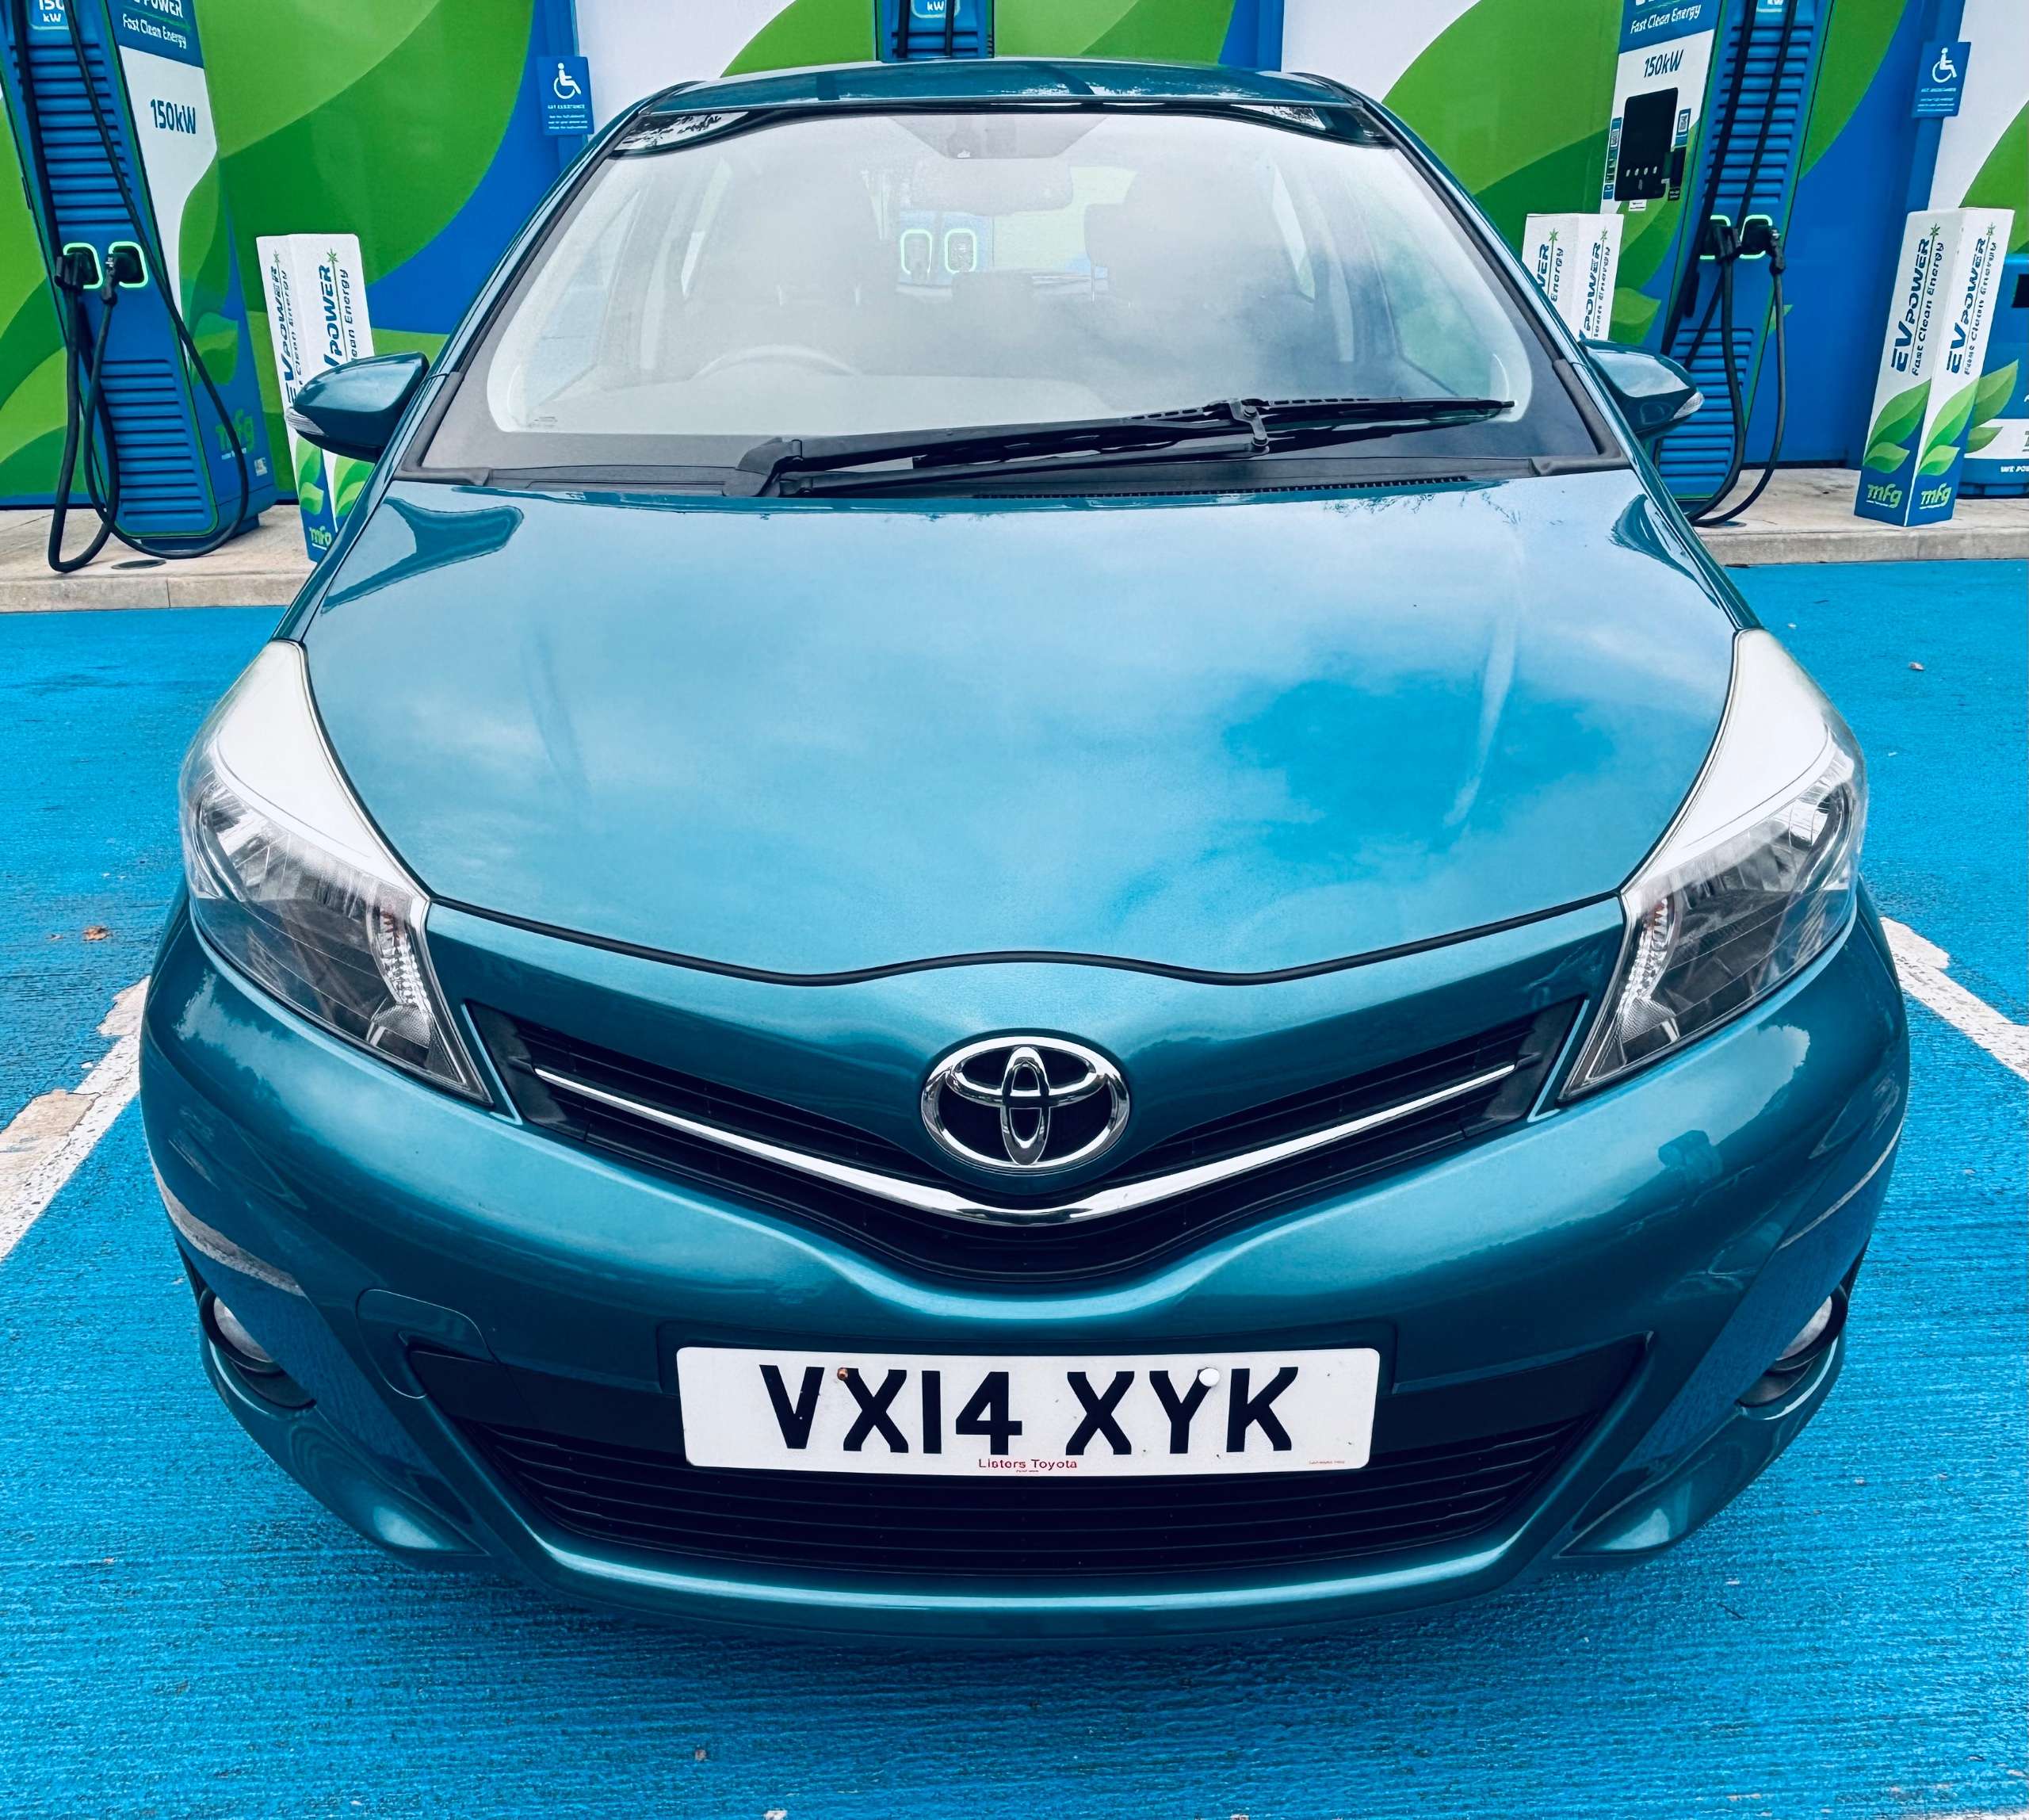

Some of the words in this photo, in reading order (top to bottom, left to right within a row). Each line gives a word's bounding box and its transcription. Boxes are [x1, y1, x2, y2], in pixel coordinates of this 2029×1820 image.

[43, 13, 61, 22] kW
[927, 1, 944, 11] kW
[1630, 19, 1647, 34] Fast
[1648, 14, 1670, 29] Clean
[1672, 5, 1701, 22] Energy
[123, 13, 139, 32] Fast
[140, 19, 162, 38] Clean
[162, 26, 186, 49] Energy
[1644, 49, 1683, 78] 150kW
[151, 99, 196, 134] 150kW
[1550, 248, 1564, 302] Energy
[340, 270, 353, 324] Energy
[1912, 346, 1924, 376] Fast
[1918, 300, 1932, 342] Clean
[1927, 242, 1944, 296] Energy
[1867, 483, 1902, 508] mfg
[1920, 483, 1952, 507] mfg
[759, 1365, 1022, 1456] VX14
[1066, 1367, 1298, 1456] XYK
[978, 1459, 1026, 1468] Listers
[1031, 1459, 1077, 1470] Toyota
